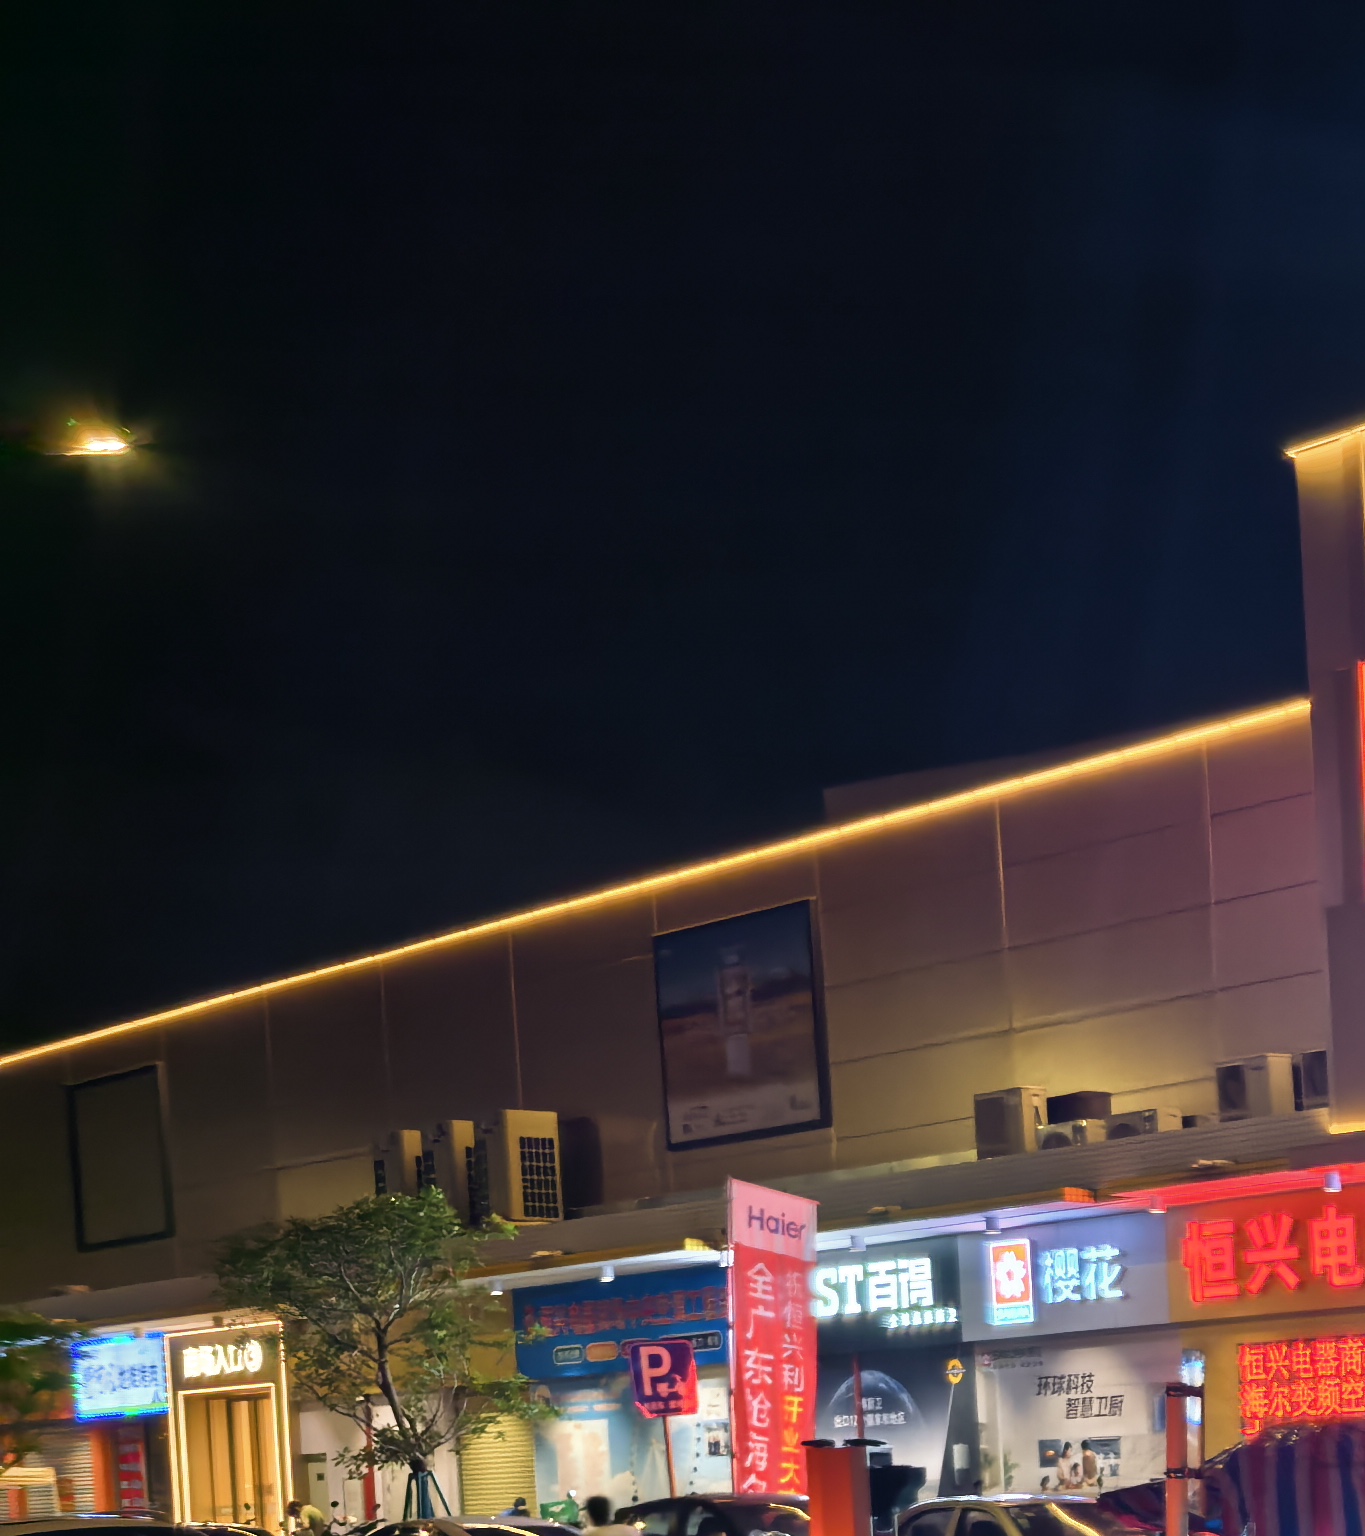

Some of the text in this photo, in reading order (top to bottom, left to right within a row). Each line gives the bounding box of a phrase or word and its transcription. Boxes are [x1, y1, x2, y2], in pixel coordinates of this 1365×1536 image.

[748, 1205, 806, 1241] Haier
[868, 1257, 934, 1312] 百得
[639, 1346, 672, 1396] P
[1036, 1372, 1095, 1396] 环球科技
[1066, 1395, 1125, 1420] 智慧卫厨
